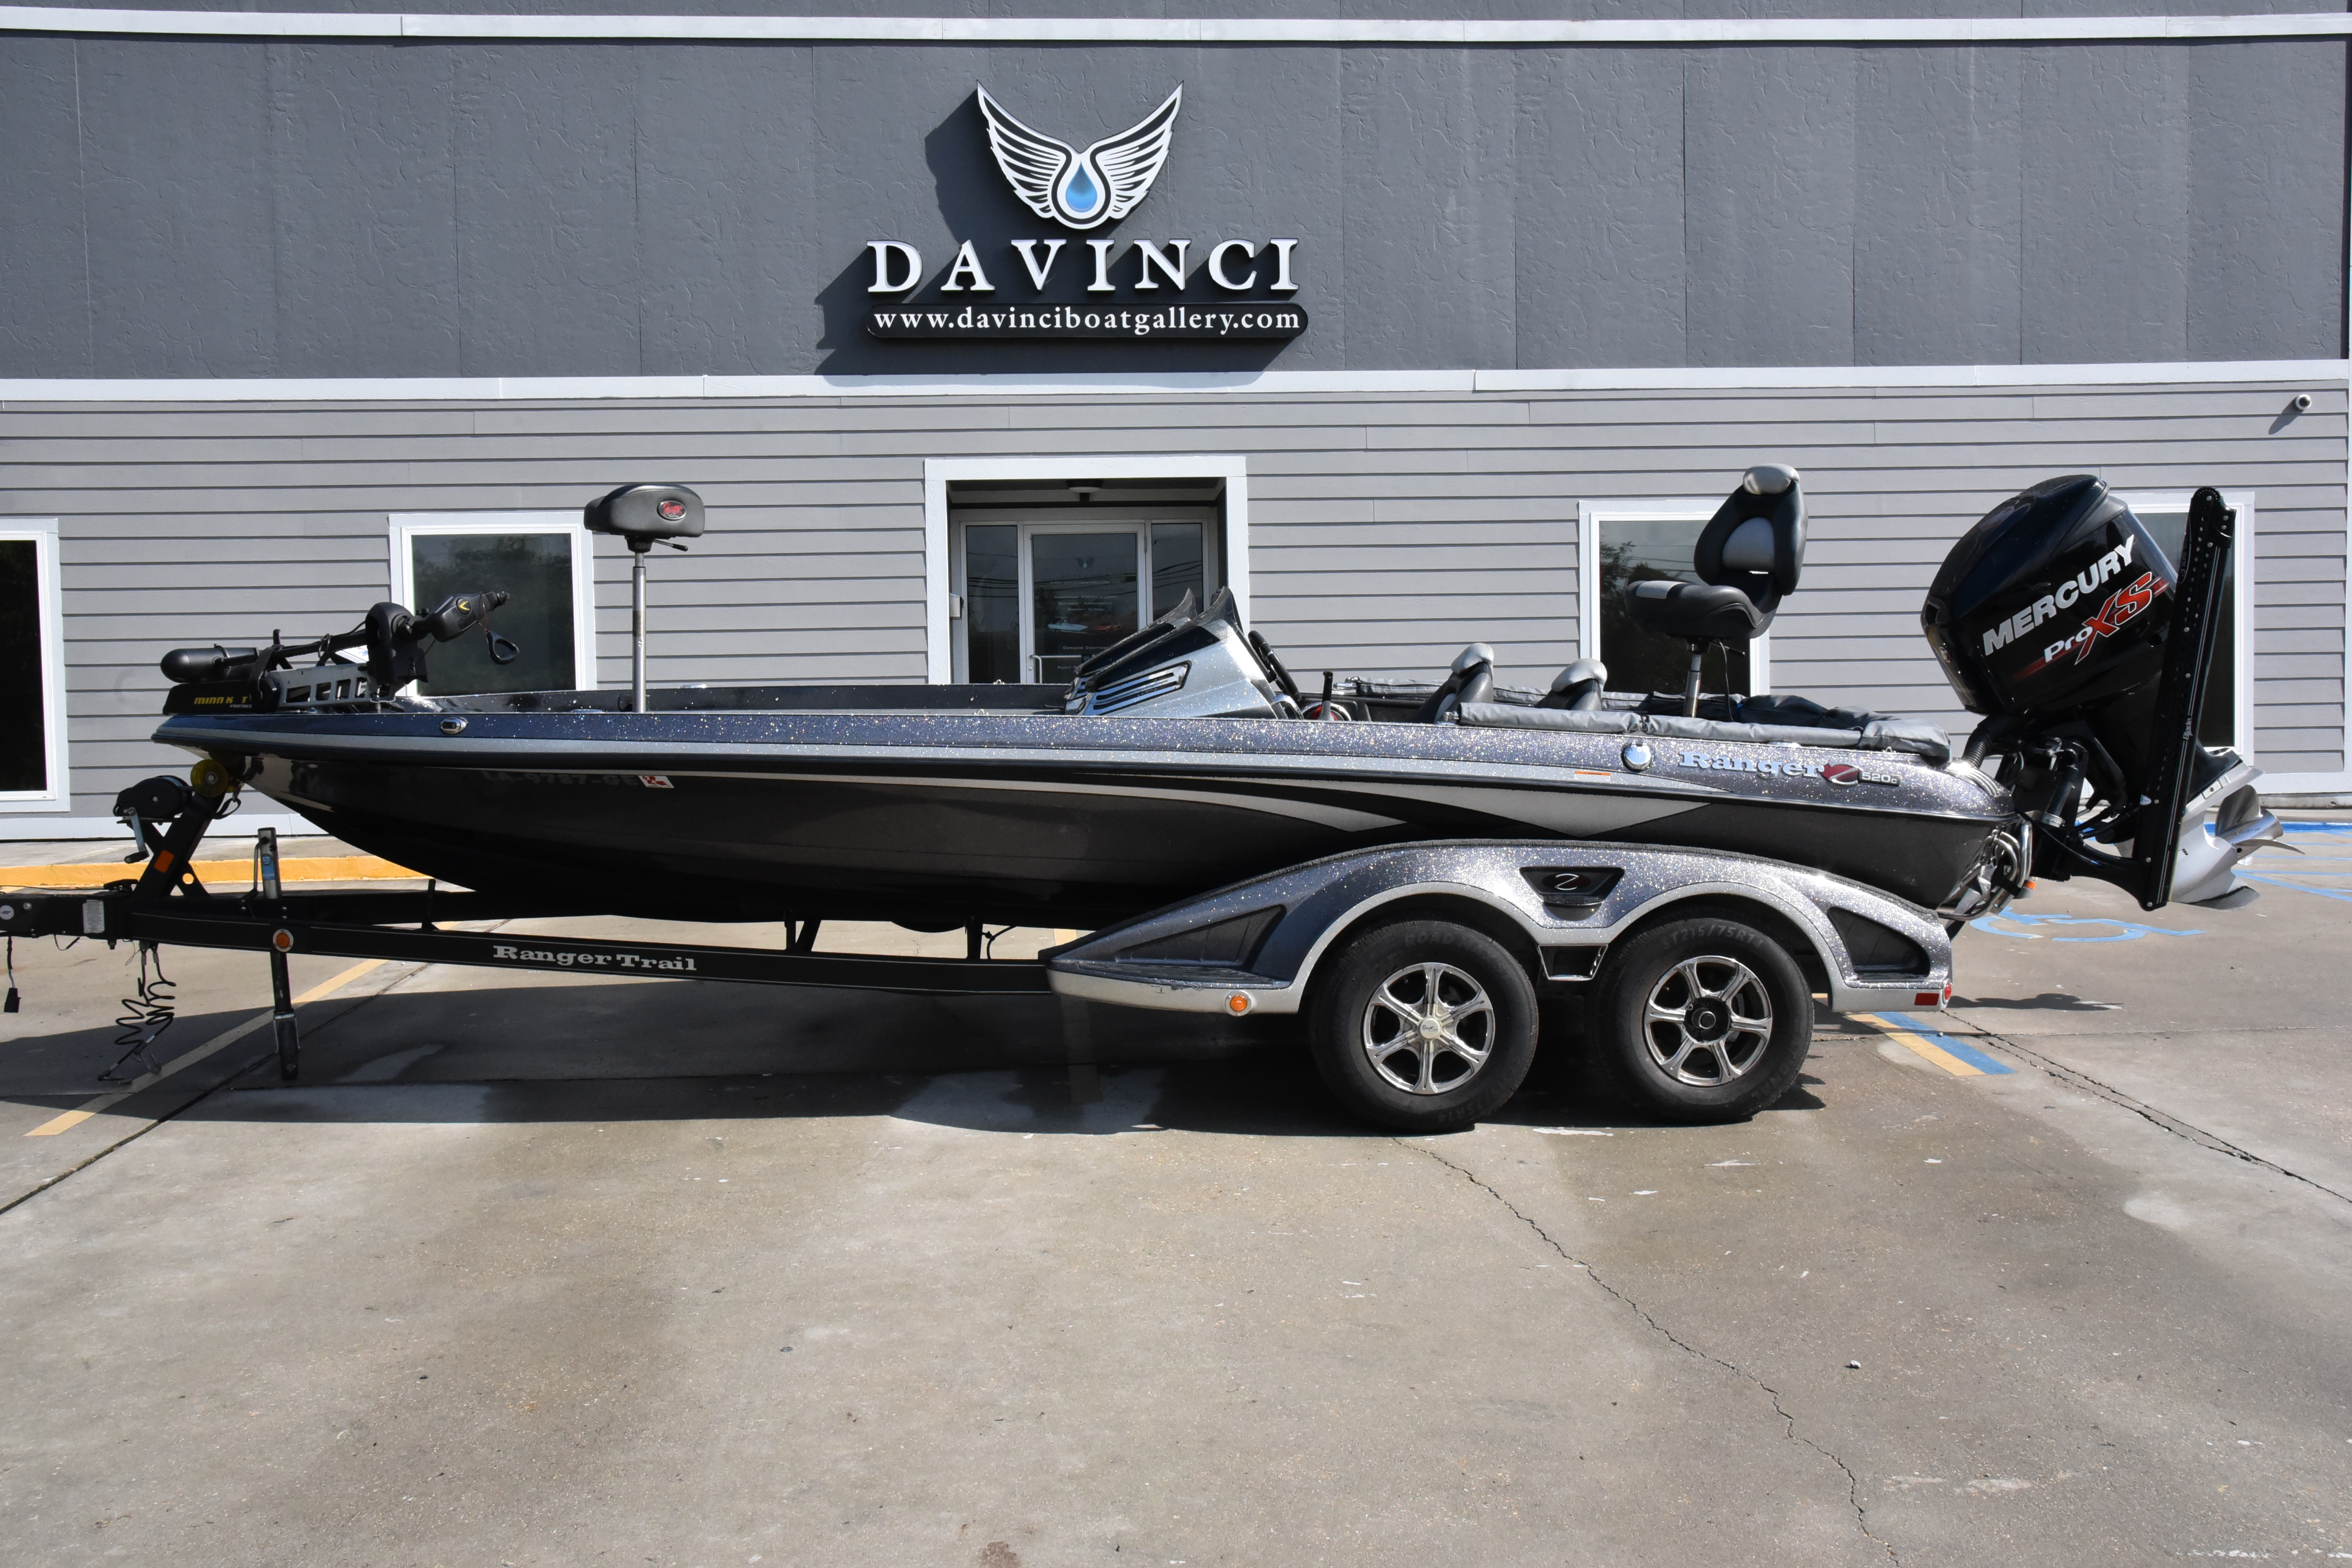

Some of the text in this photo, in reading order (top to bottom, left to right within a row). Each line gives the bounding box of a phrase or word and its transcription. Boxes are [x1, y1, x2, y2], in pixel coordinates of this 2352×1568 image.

[867, 238, 1300, 293] DAVINCI
[874, 307, 1300, 336] www.davinciboatgallery.com
[1982, 534, 2134, 656] MERCURY
[1679, 752, 1824, 779] Ranger
[493, 945, 697, 971] Ranger Trail
